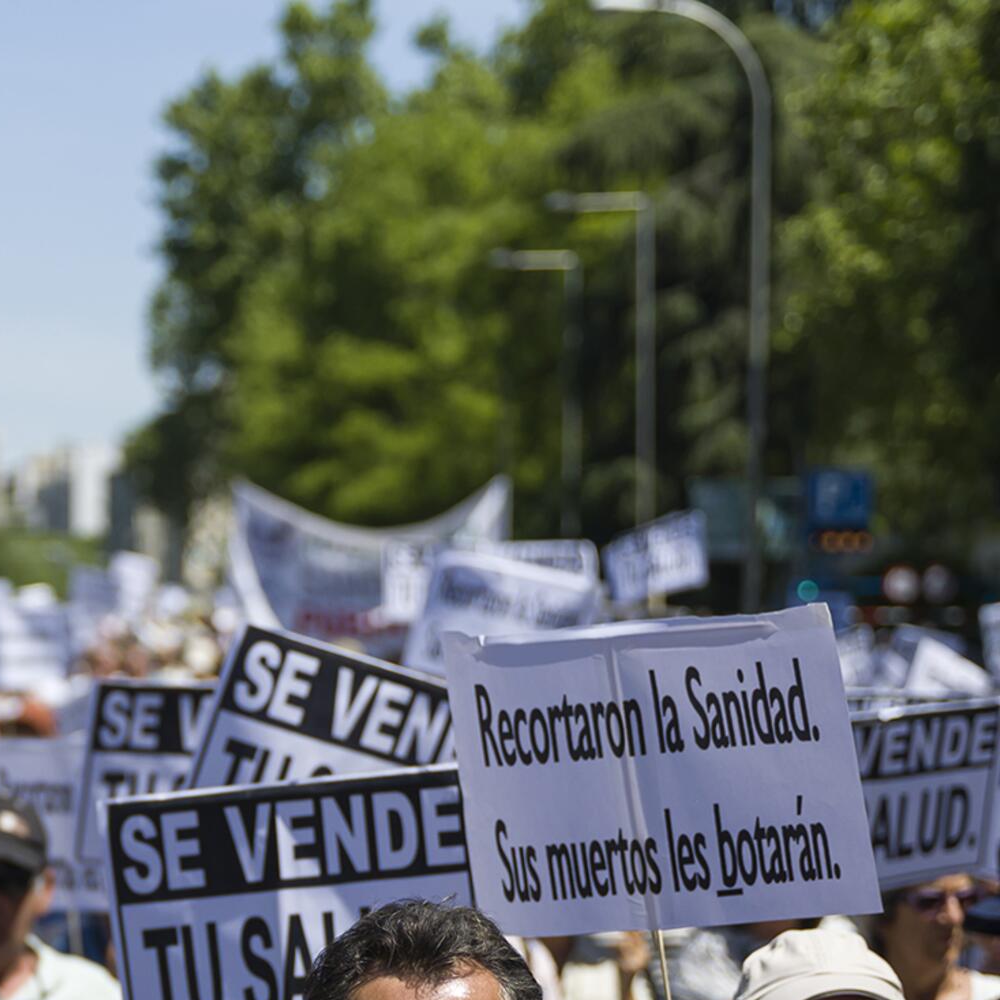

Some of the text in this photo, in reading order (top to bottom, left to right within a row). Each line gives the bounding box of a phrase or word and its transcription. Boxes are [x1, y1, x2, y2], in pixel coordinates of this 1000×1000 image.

[98, 691, 165, 750] SE
[234, 640, 320, 726] SE
[331, 666, 456, 766] VEN
[474, 657, 820, 768] Recortaron la Sanidad.
[853, 712, 996, 777] VENDE
[119, 788, 466, 895] SE VENDE
[495, 795, 842, 904] Sus muertos les botarán.
[867, 785, 976, 859] ALUD.
